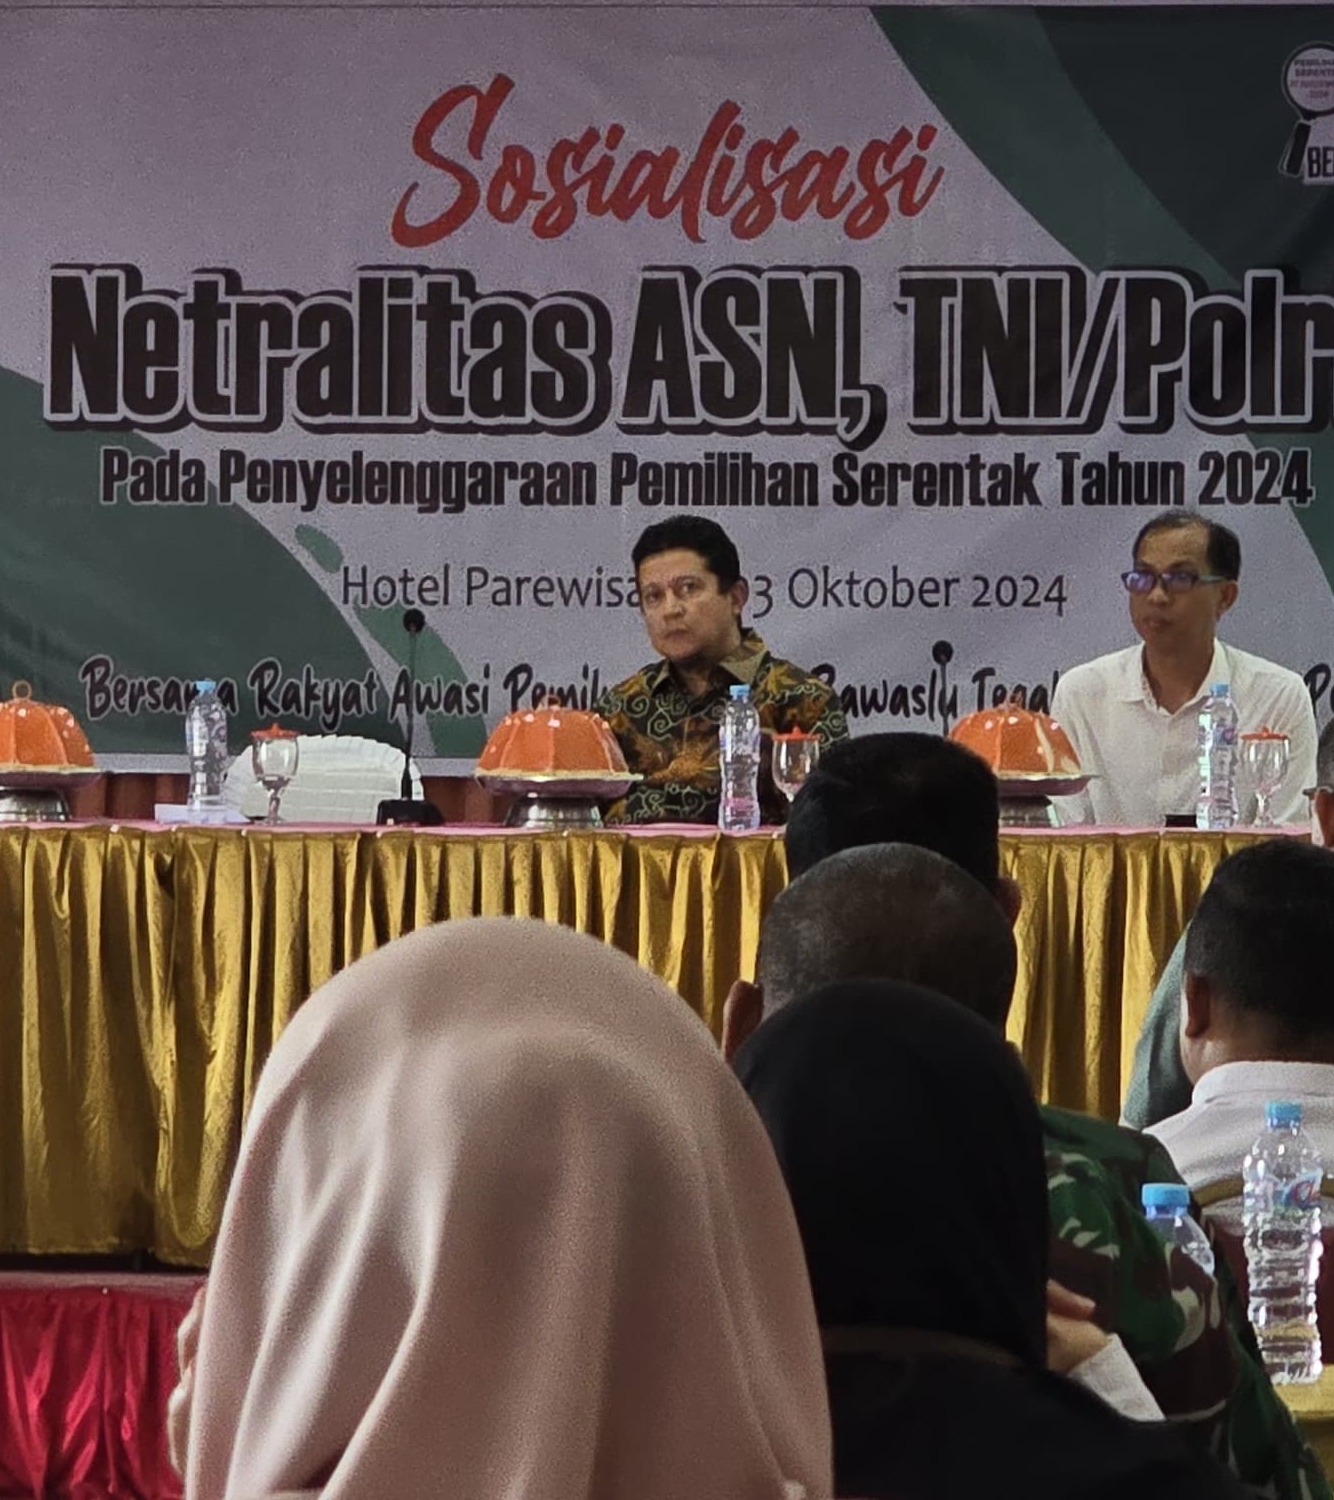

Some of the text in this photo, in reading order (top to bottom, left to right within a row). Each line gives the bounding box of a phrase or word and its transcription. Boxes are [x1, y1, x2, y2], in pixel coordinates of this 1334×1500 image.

[391, 72, 944, 248] Sosialisasi
[44, 264, 613, 436] Netralitas
[617, 264, 889, 452] ASN,
[102, 449, 1315, 513] Pada Penyelenggaraan Pemilihan Serentak Tahun 2024
[342, 563, 450, 606] Hotel
[466, 565, 641, 607] Parewisa
[788, 565, 960, 609] Oktober
[971, 574, 1067, 617] 2024
[249, 658, 381, 731] Rakyat
[390, 663, 490, 722] Awasi
[503, 662, 612, 712] Pemil
